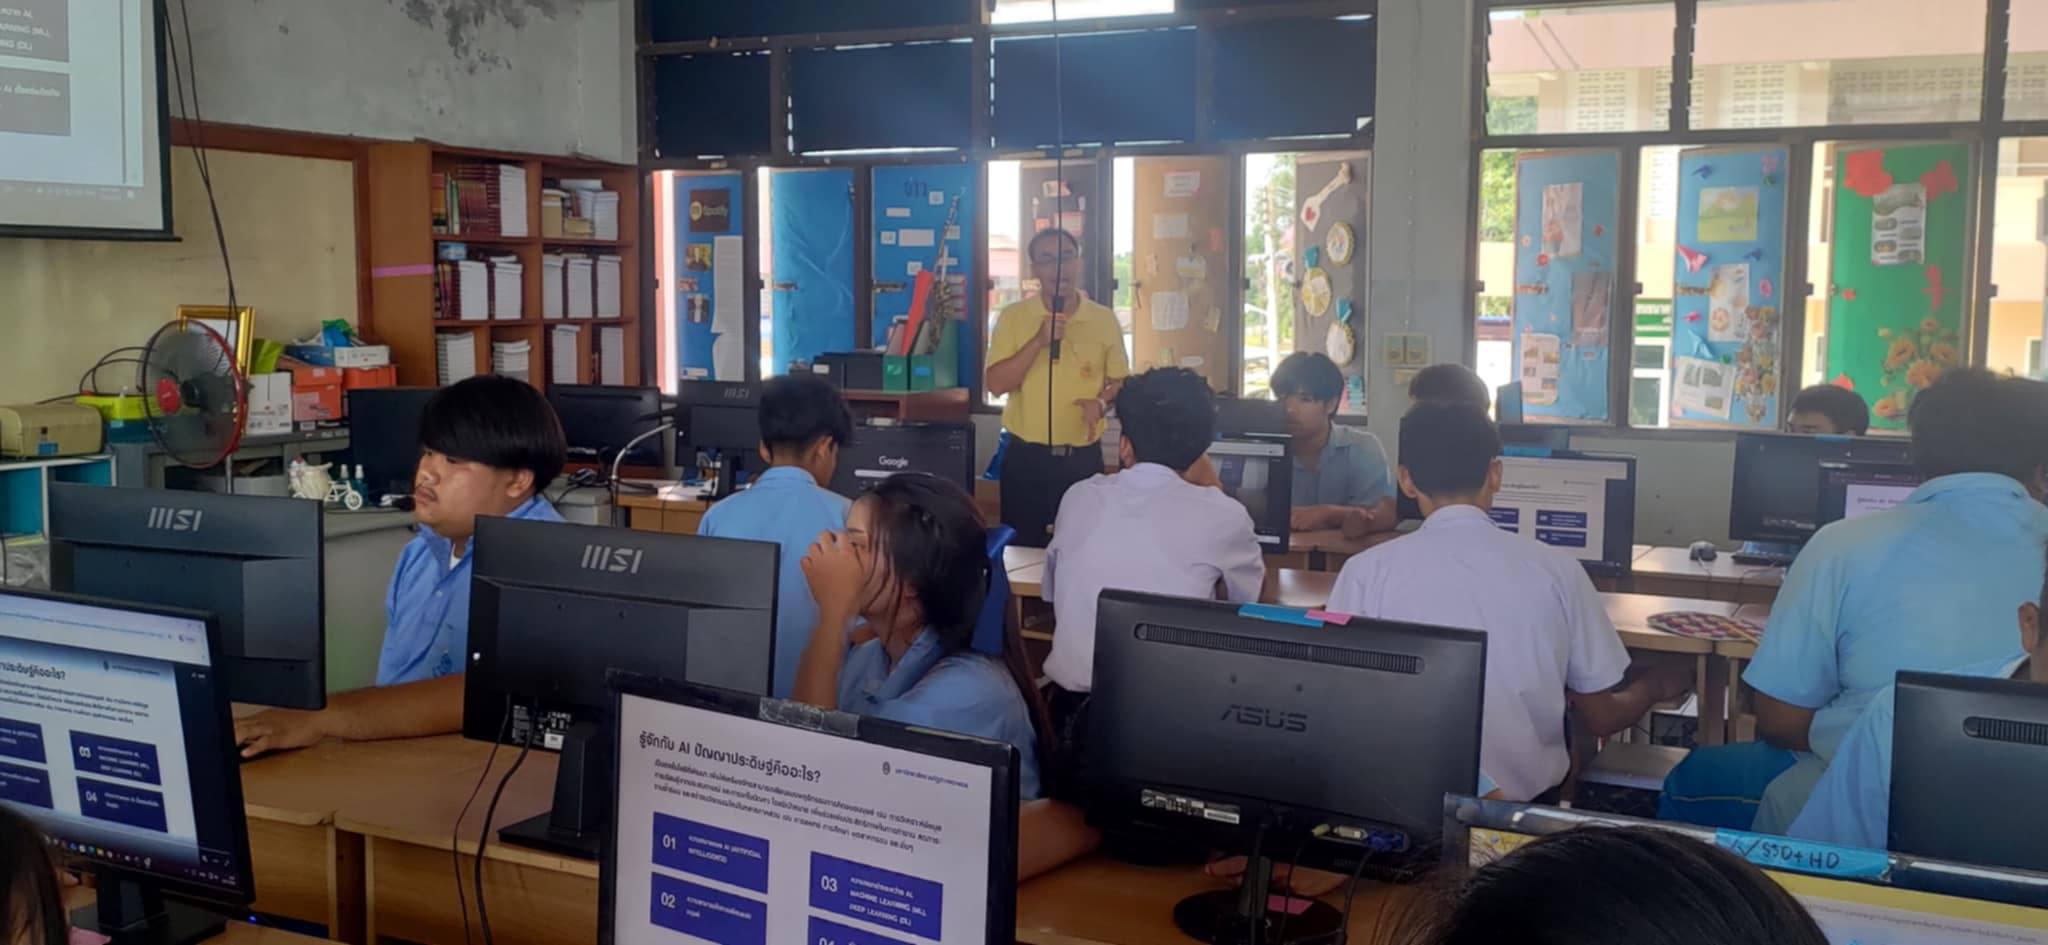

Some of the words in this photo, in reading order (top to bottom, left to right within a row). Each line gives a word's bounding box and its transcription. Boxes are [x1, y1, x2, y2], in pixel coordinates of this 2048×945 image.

[878, 455, 909, 469] Google
[148, 507, 202, 532] MSI
[581, 544, 643, 574] MSI
[1221, 703, 1308, 732] ASUS
[678, 741, 691, 755] AI
[662, 834, 676, 850] 01
[820, 875, 838, 892] 03
[661, 892, 676, 908] 02
